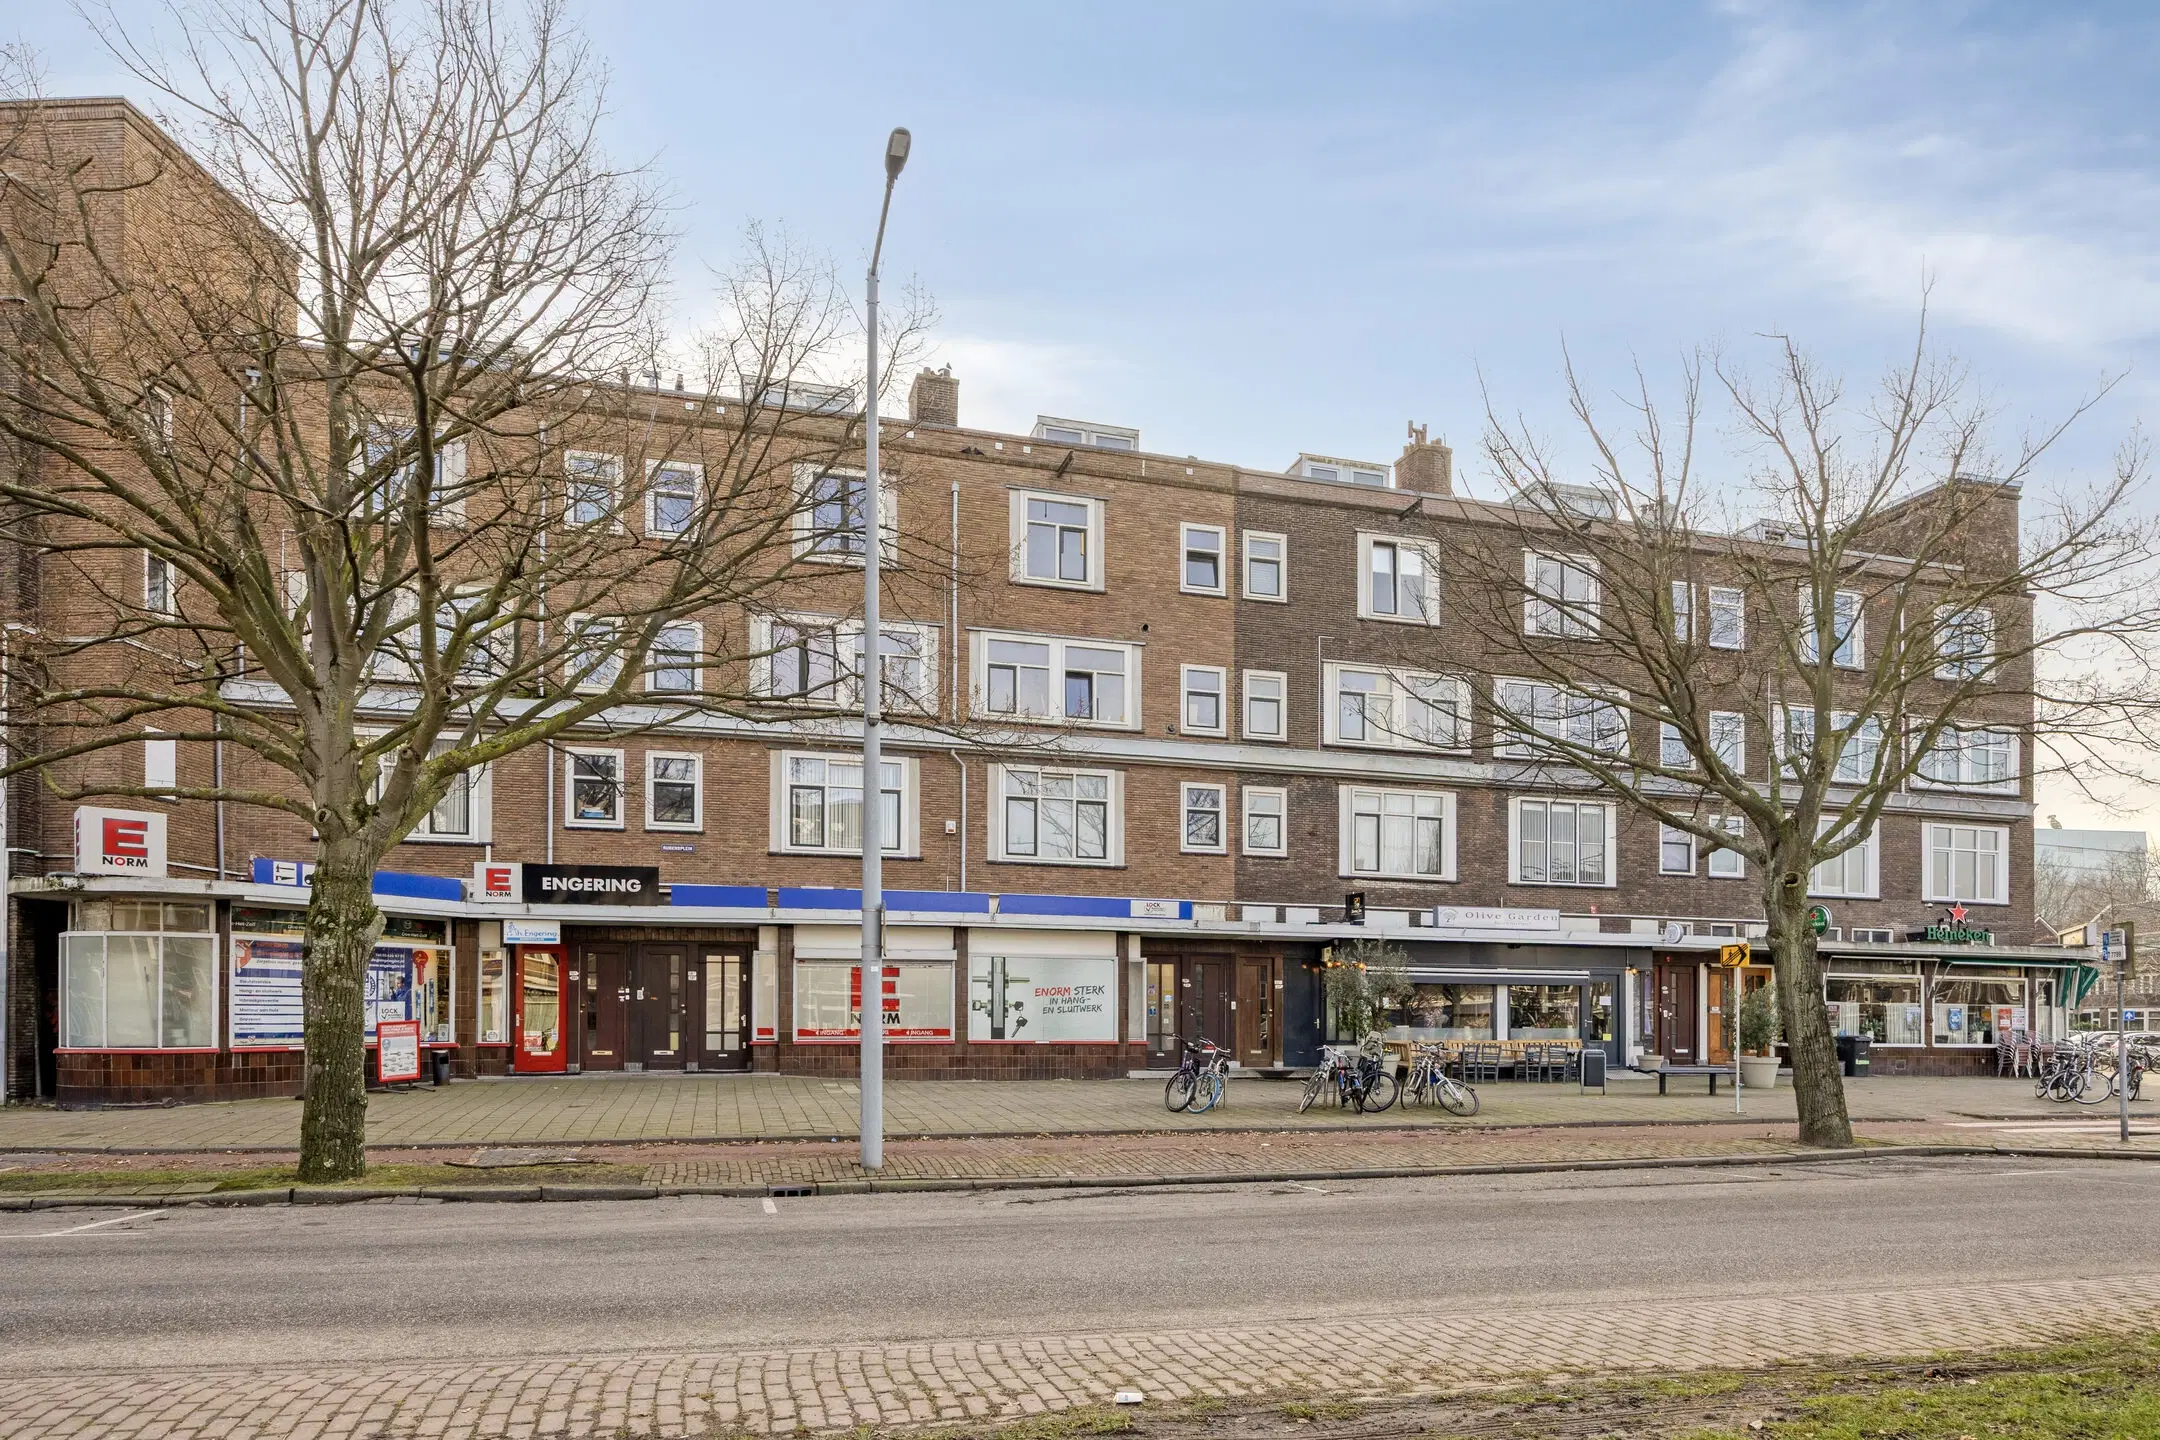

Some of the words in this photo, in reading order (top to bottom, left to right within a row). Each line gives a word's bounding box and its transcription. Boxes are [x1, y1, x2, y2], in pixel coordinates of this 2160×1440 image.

[102, 817, 149, 858] E
[102, 855, 149, 868] NORM
[485, 868, 512, 891] E
[541, 876, 642, 893] ENGERING
[1465, 911, 1502, 920] Olive
[1508, 912, 1559, 921] Garden
[524, 928, 557, 938] Engering
[1927, 926, 1989, 942] Heineken
[1034, 987, 1071, 997] ENORM
[1073, 985, 1105, 996] STERK
[1049, 997, 1059, 1006] IN
[1061, 996, 1092, 1005] HANG-
[1042, 1006, 1055, 1015] EN
[1057, 1004, 1103, 1014] SLUITWERK
[850, 1012, 901, 1025] NRM
